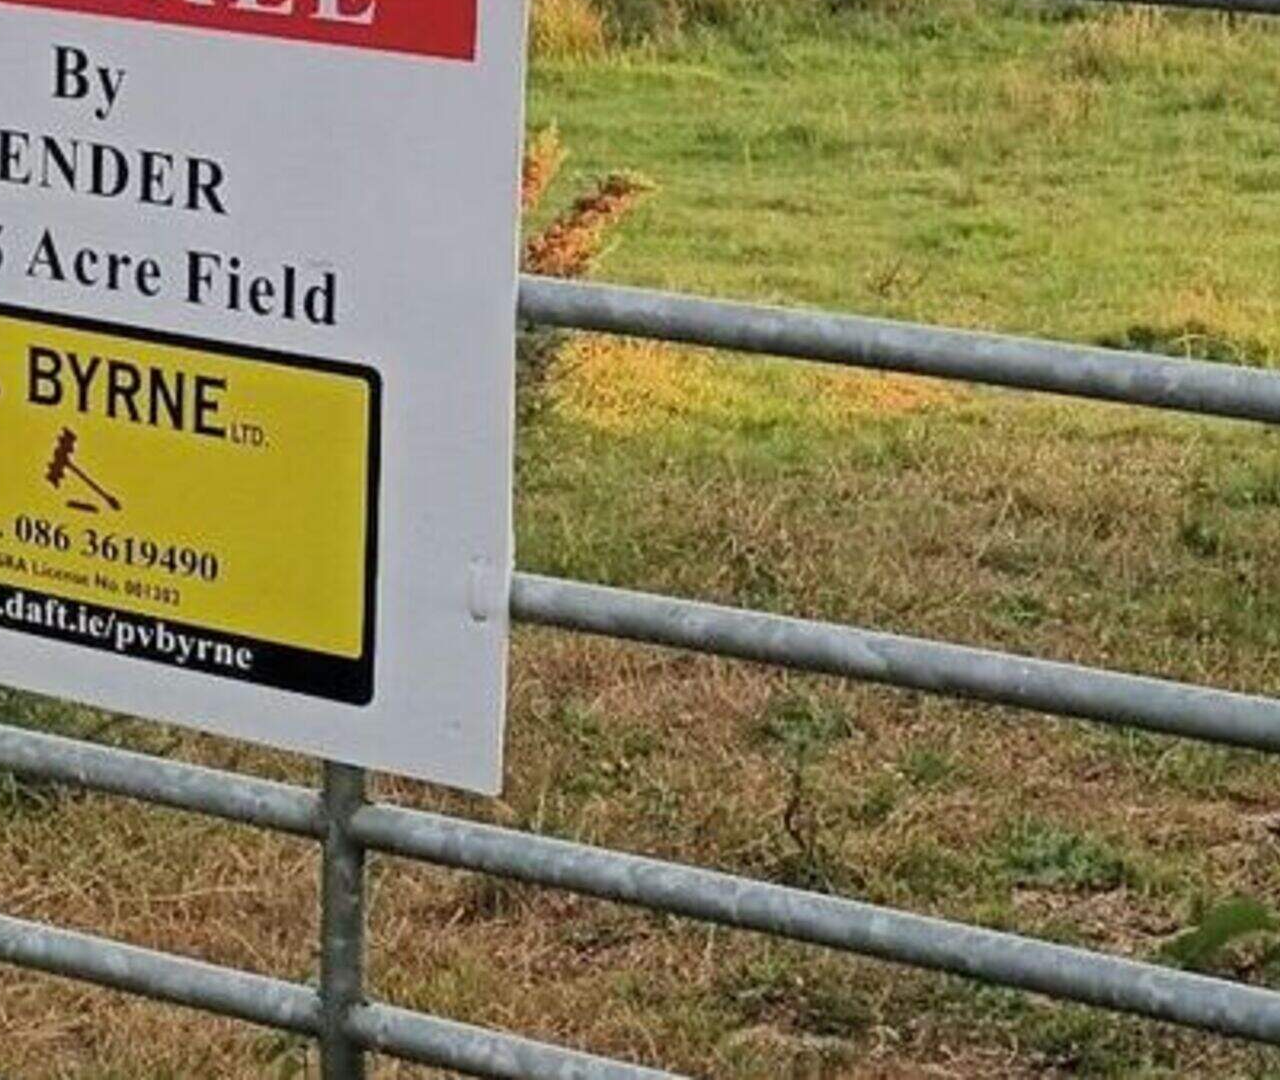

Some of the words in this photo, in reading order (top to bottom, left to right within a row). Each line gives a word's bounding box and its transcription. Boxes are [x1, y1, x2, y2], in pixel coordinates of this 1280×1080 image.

[51, 44, 126, 120] By
[26, 228, 161, 297] Acre
[186, 250, 338, 326] Field
[28, 345, 227, 439] BYRNE
[230, 423, 271, 449] LTD.
[15, 514, 70, 552] 086
[80, 528, 219, 581] 3619490
